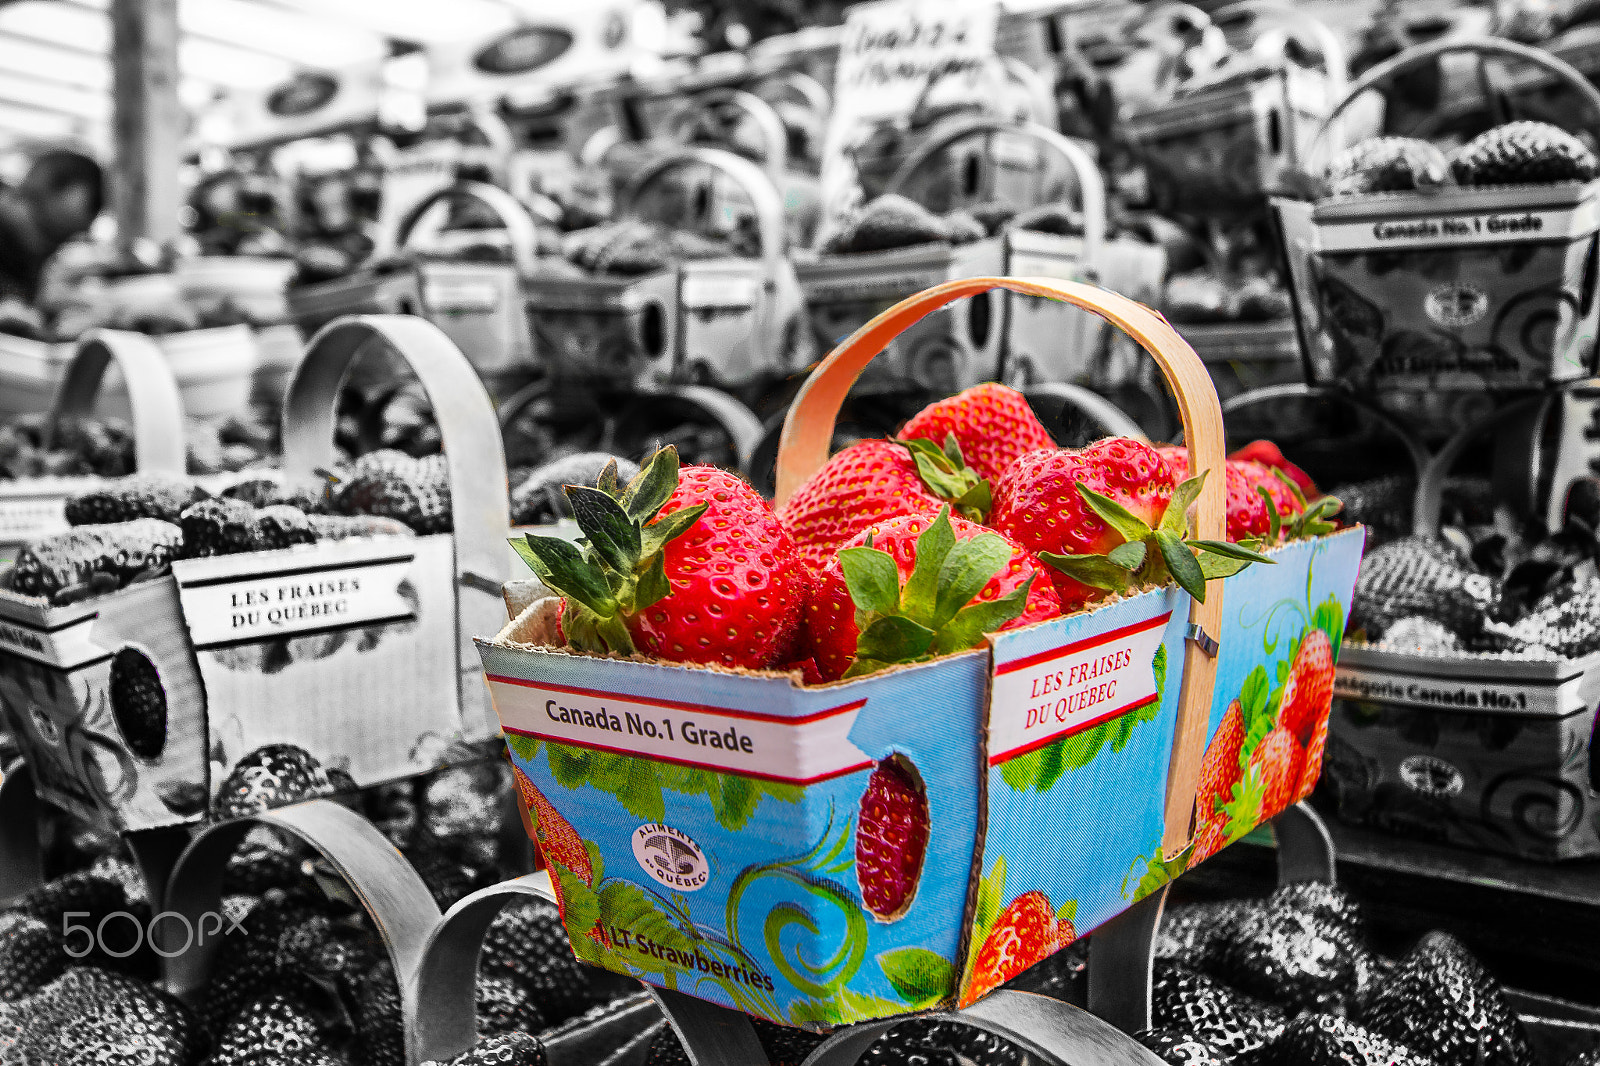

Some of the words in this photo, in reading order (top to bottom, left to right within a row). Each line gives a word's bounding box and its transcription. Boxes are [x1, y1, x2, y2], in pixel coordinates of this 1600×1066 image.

[1373, 220, 1438, 240] Canada
[1486, 213, 1543, 233] Grade
[231, 589, 269, 607] LES
[278, 578, 360, 600] FRAISES
[231, 610, 260, 627] DU
[1030, 670, 1063, 699] LES
[1067, 648, 1132, 687] FRAISES
[1024, 702, 1052, 730] DU
[1055, 680, 1117, 723] QUÉBEC
[1407, 684, 1478, 706] Canada
[545, 700, 622, 732] Canada
[681, 721, 753, 753] Grade
[638, 824, 701, 852] ALIMENTS
[656, 869, 706, 887] QUÉBEC
[610, 925, 631, 950] LT
[635, 933, 775, 992] Strawberries
